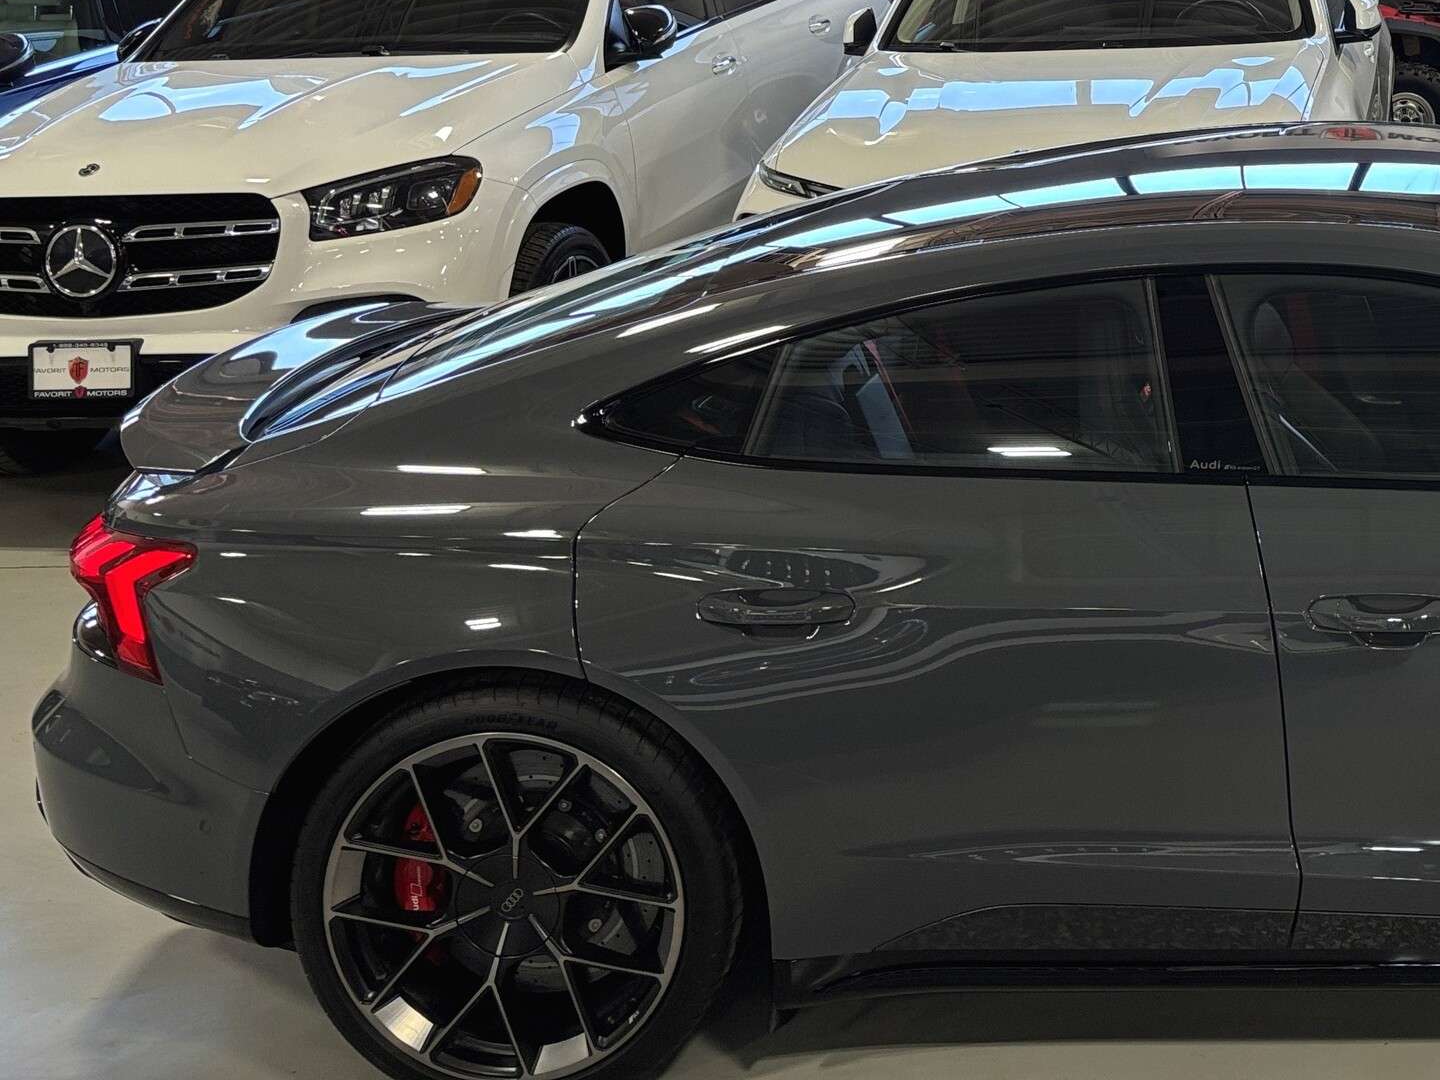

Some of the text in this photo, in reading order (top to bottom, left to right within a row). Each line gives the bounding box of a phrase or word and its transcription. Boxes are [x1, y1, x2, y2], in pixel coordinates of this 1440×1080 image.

[87, 389, 128, 397] MOTORS
[1190, 460, 1221, 470] Audi
[411, 895, 420, 911] udi
